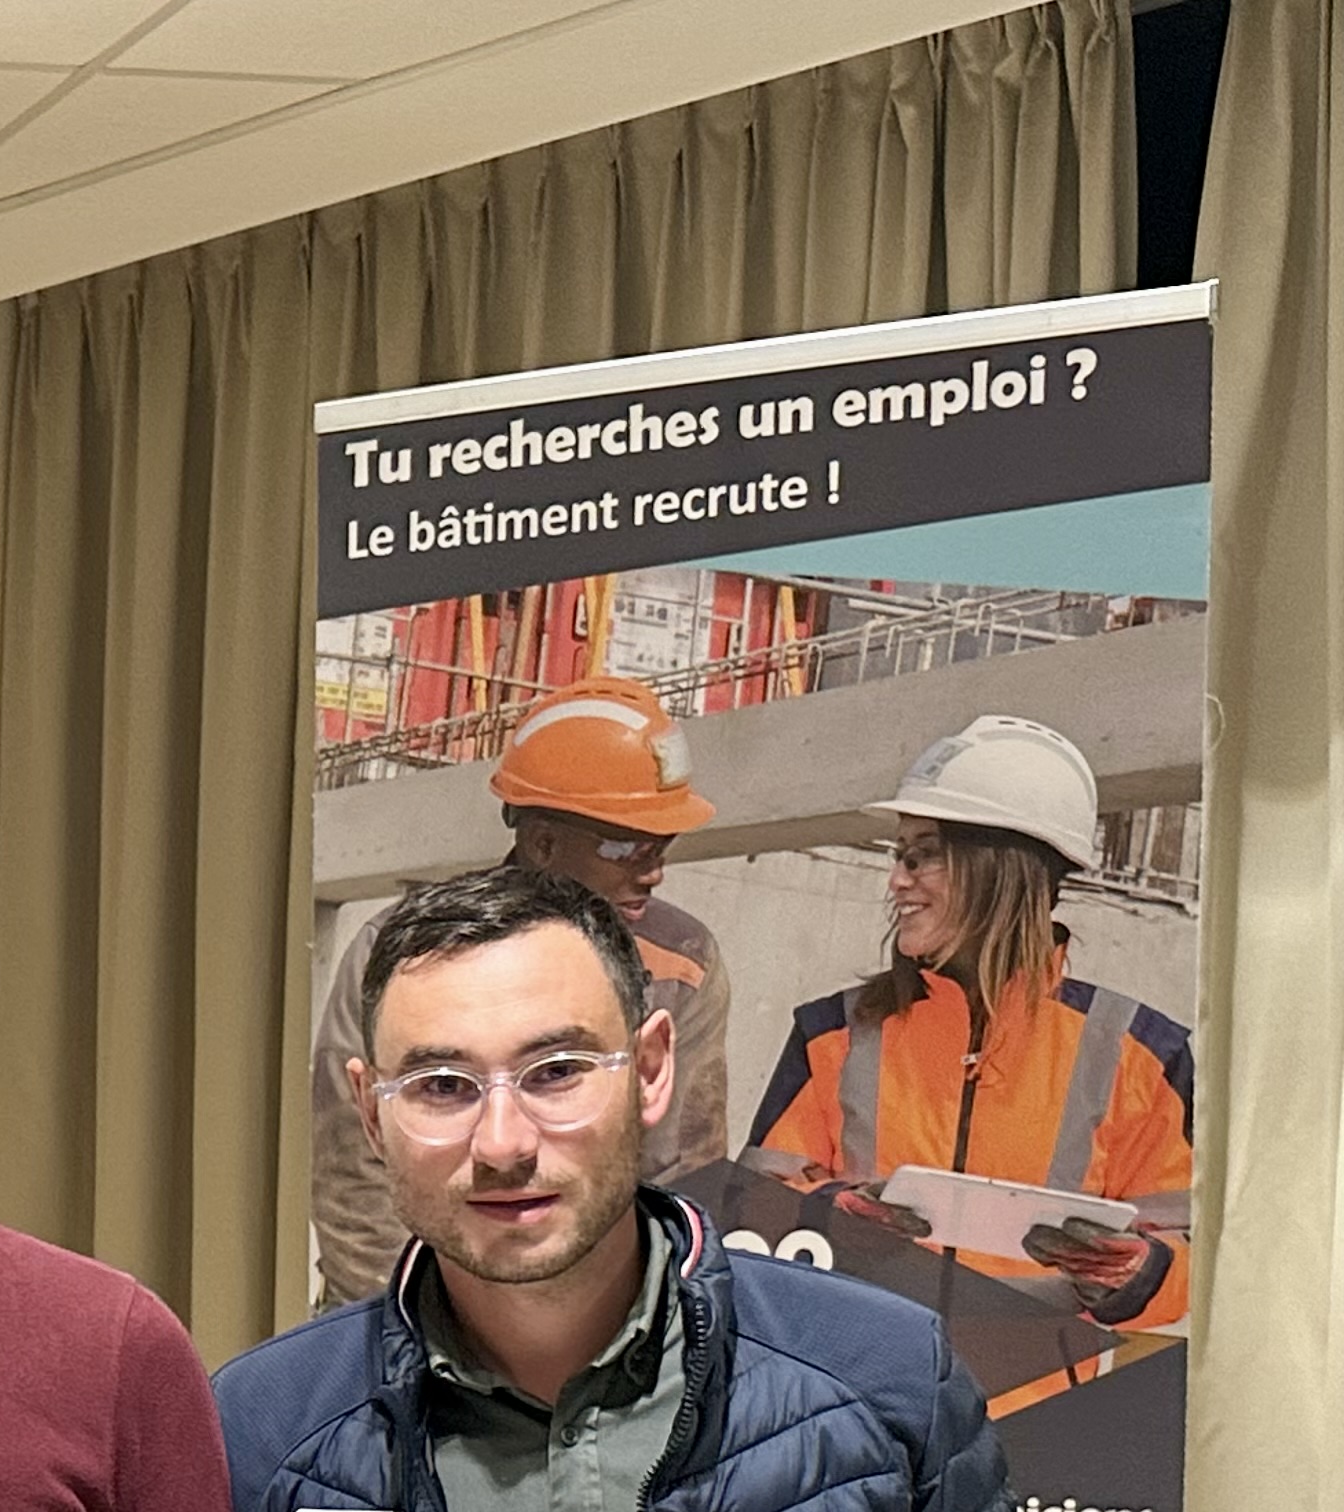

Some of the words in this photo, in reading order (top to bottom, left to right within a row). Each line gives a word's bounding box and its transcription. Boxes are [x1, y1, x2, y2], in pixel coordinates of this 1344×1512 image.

[345, 440, 412, 487] Tu
[428, 403, 720, 478] recherches
[738, 394, 814, 439] un
[832, 354, 1047, 427] emploi
[1065, 347, 1099, 401] ?
[347, 520, 395, 560] Le
[409, 491, 619, 553] bâtiment
[633, 472, 808, 526] recrute
[826, 460, 841, 505] !
